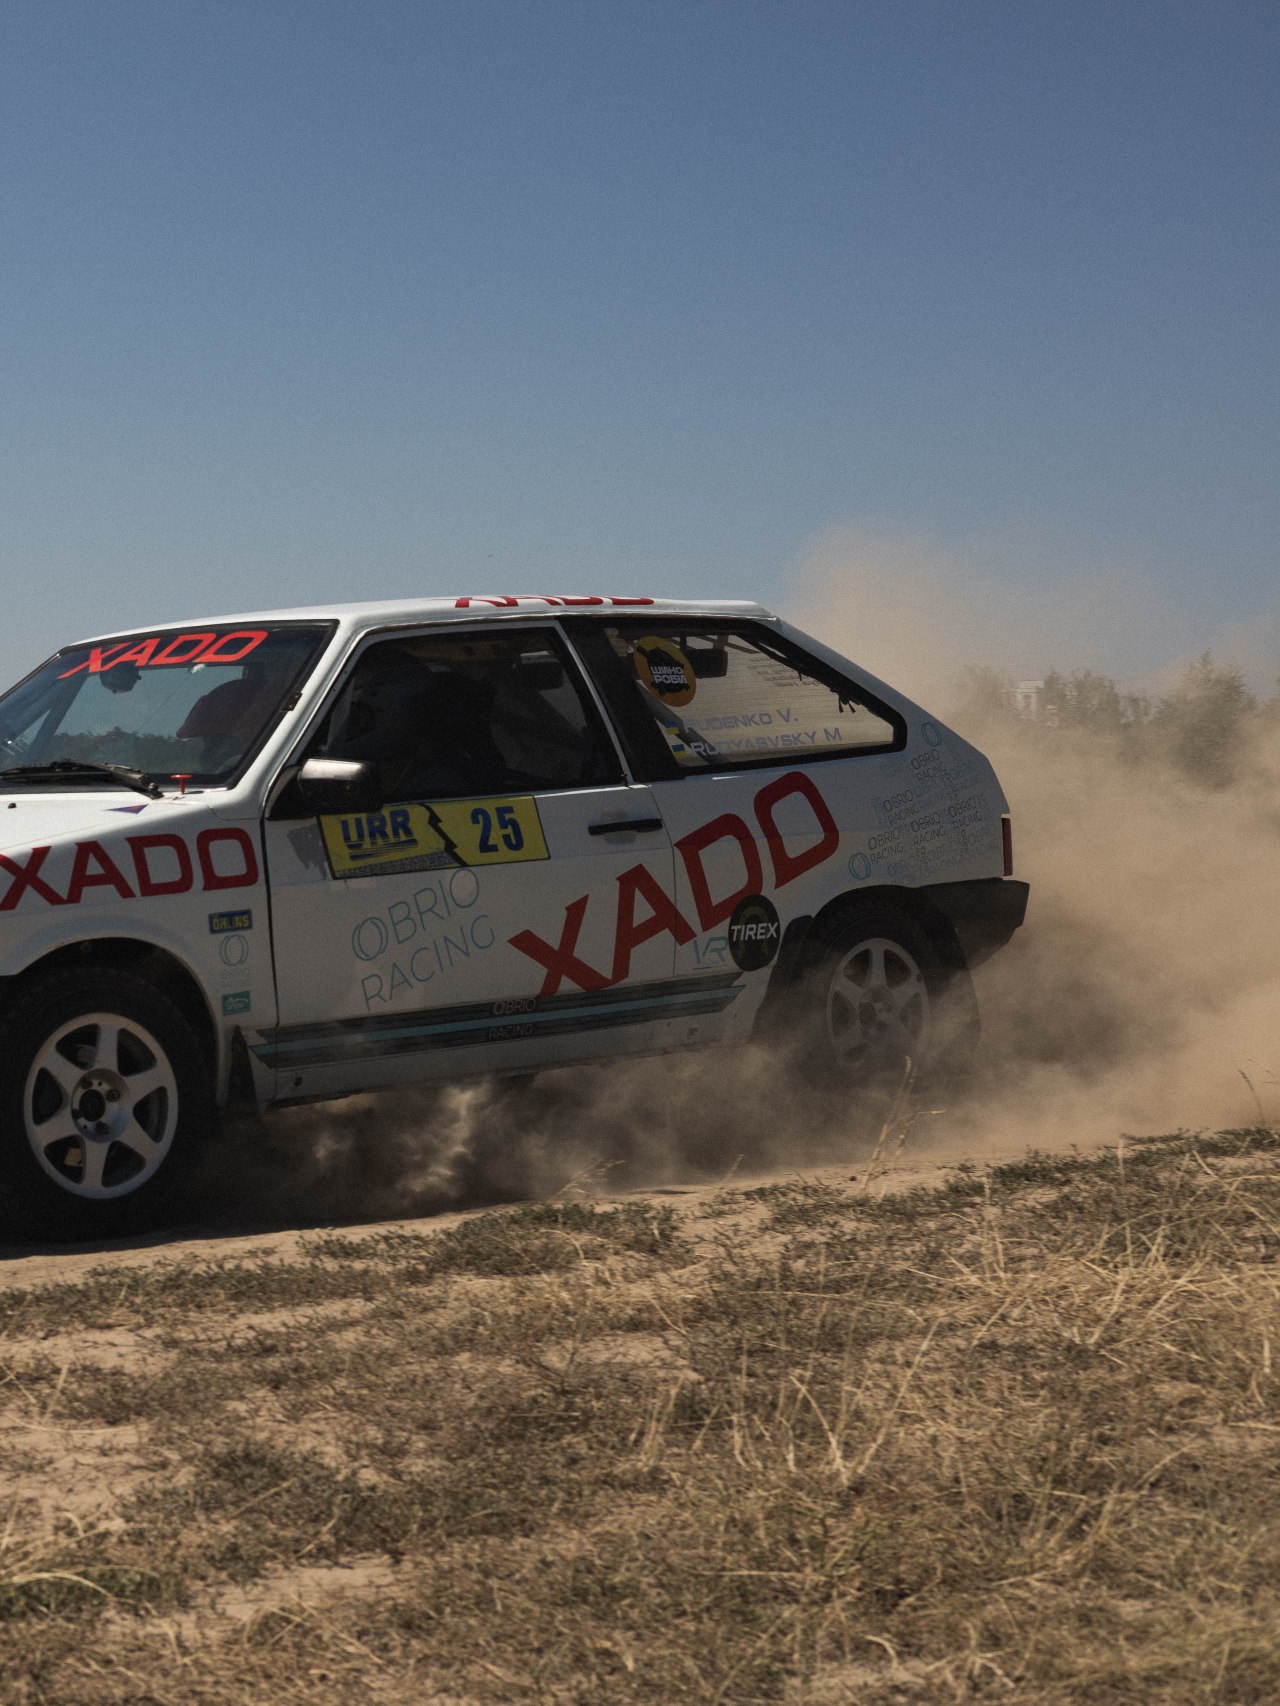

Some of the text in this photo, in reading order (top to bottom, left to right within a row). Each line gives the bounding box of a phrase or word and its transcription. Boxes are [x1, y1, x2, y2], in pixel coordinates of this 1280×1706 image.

[57, 630, 270, 680] XADO
[650, 666, 684, 675] ШИНО
[653, 674, 688, 684] РОБИ
[684, 713, 773, 733] RUDENKO
[911, 748, 941, 770] OBRIO
[917, 761, 947, 783] RACING
[883, 789, 914, 812] OBRIO
[947, 796, 977, 818] OBRIO
[888, 802, 921, 826] RACING
[910, 811, 941, 833] OBRIO
[341, 806, 524, 853] URR 25
[868, 827, 901, 851] OBRIO
[913, 825, 946, 847] RACING
[870, 841, 904, 864] RACING
[507, 771, 839, 996] XADO
[352, 867, 480, 961] OBRIO
[731, 922, 778, 942] TIREX
[361, 914, 495, 1011] RACING
[493, 998, 537, 1015] OBRIO
[488, 1024, 534, 1040] RACING
